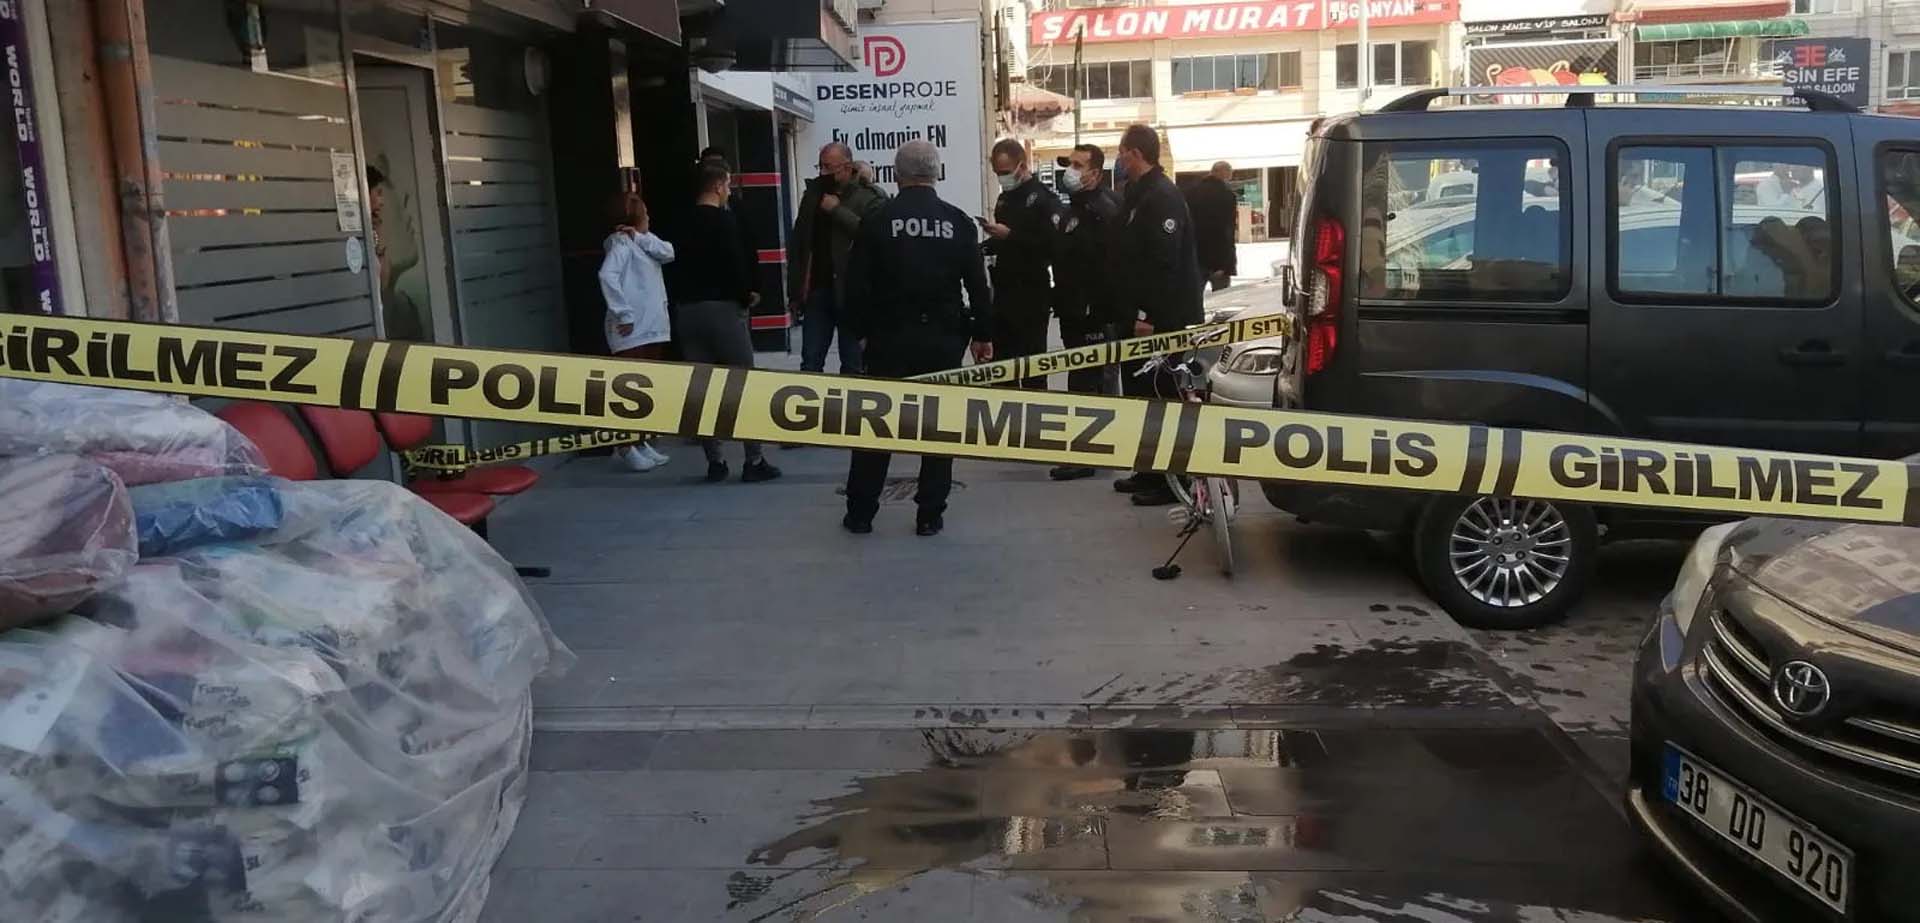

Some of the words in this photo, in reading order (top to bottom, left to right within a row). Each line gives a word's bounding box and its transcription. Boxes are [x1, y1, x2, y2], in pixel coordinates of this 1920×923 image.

[1042, 10, 1167, 41] SALON
[1182, 3, 1315, 33] MURAT
[5, 44, 29, 142] WORLD
[816, 80, 957, 101] DESENPROJE
[1823, 66, 1860, 82] EFE
[23, 166, 45, 262] WORLD
[1679, 762, 1710, 815] 38
[1729, 792, 1766, 852] DD
[1787, 829, 1843, 903] 920
